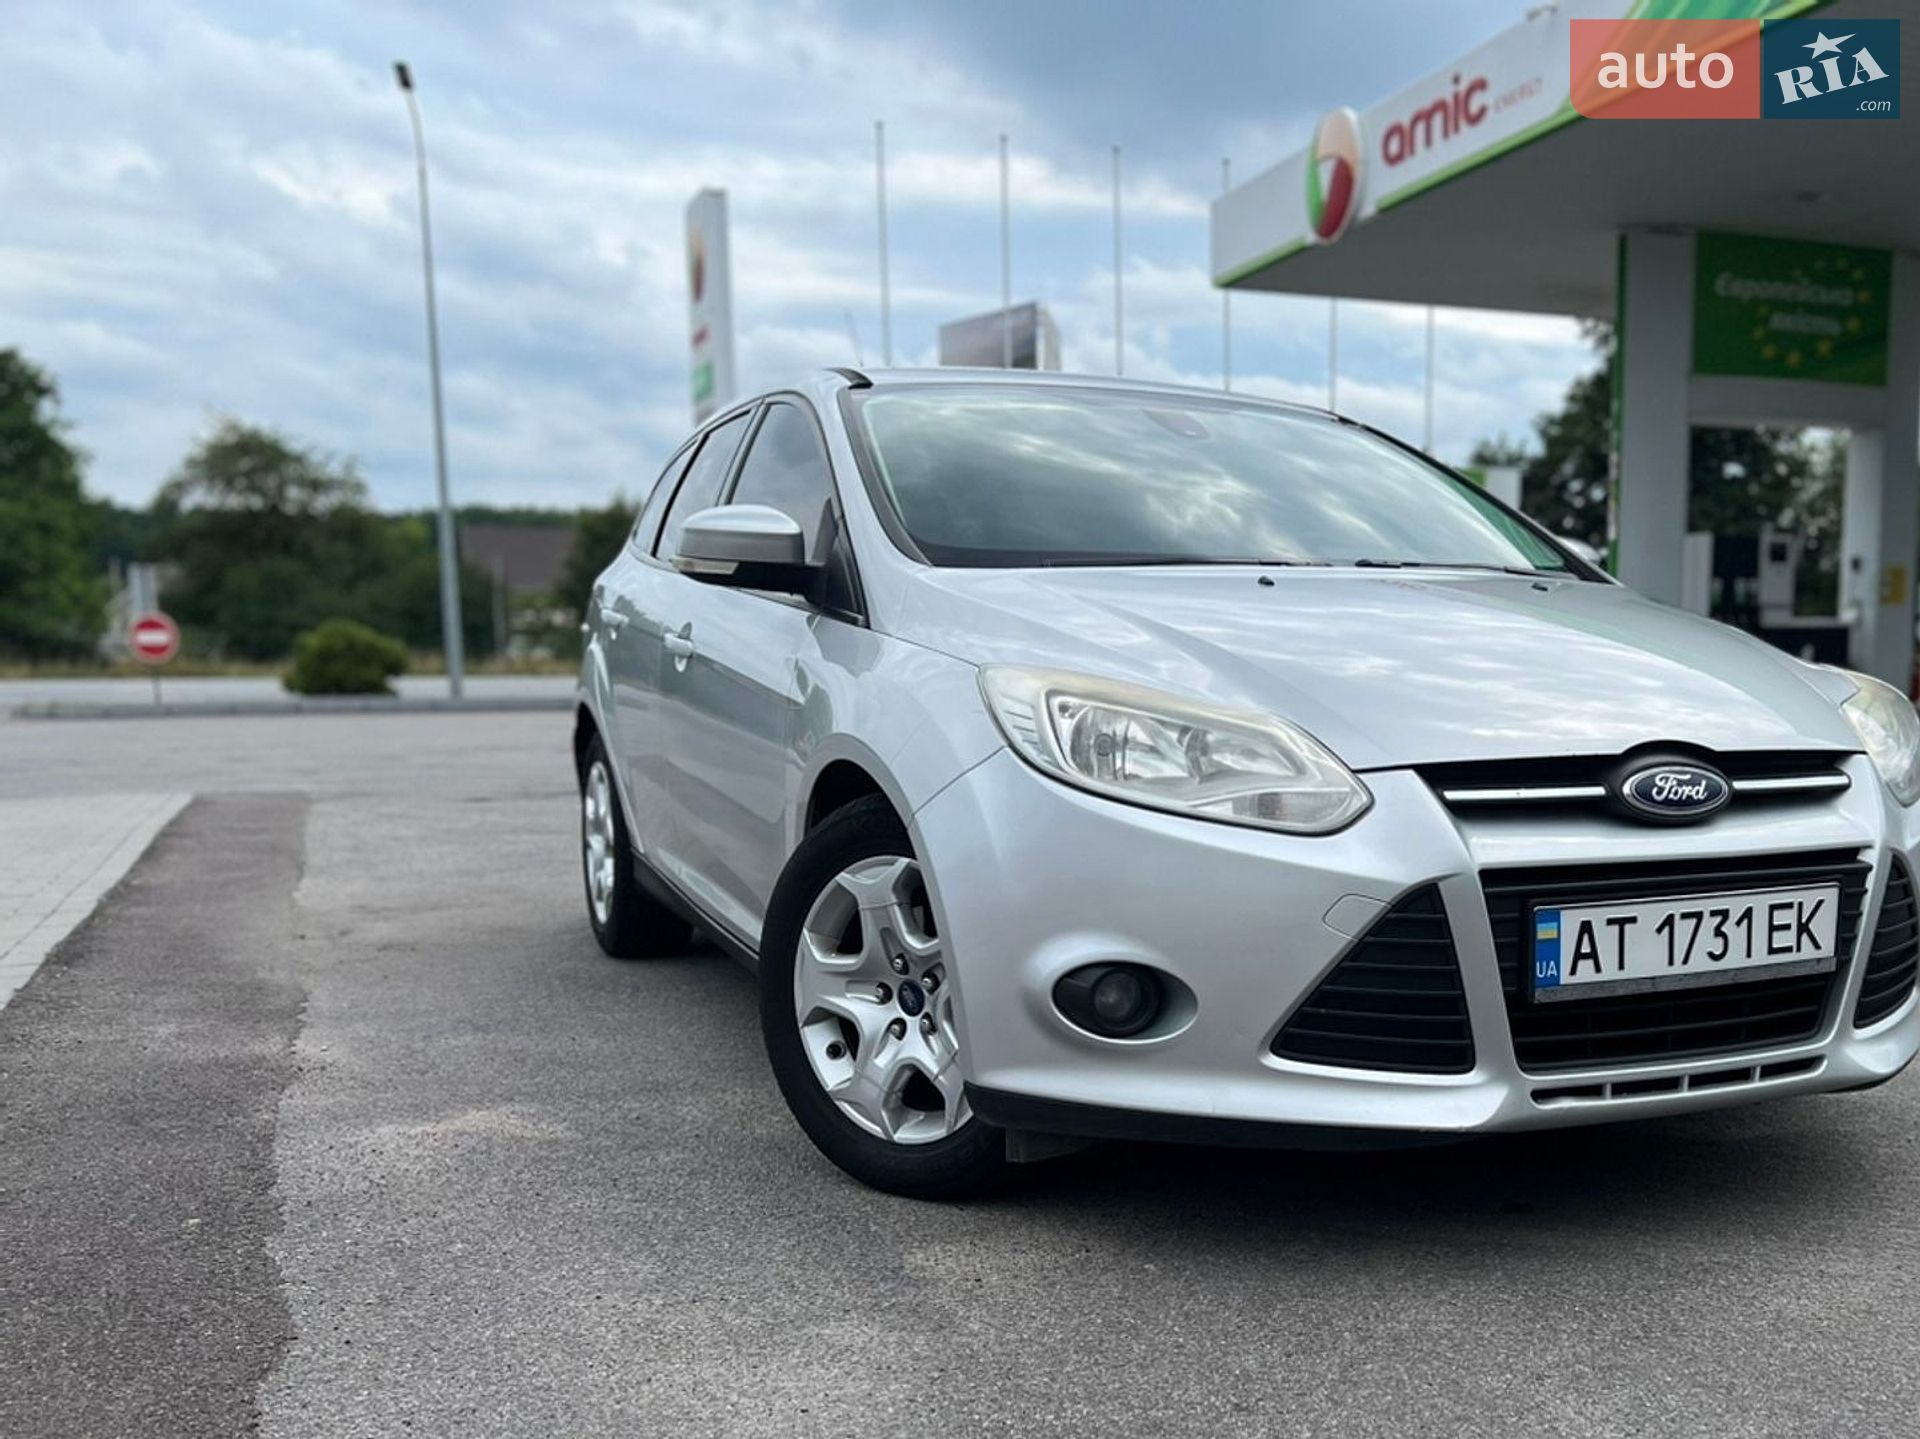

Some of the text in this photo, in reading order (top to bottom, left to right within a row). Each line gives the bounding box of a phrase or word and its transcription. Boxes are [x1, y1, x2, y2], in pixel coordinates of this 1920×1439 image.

[1382, 73, 1488, 166] amic
[1651, 774, 1707, 801] Ford
[1569, 898, 1825, 976] AT 1731 EK
[1536, 960, 1558, 978] UA
